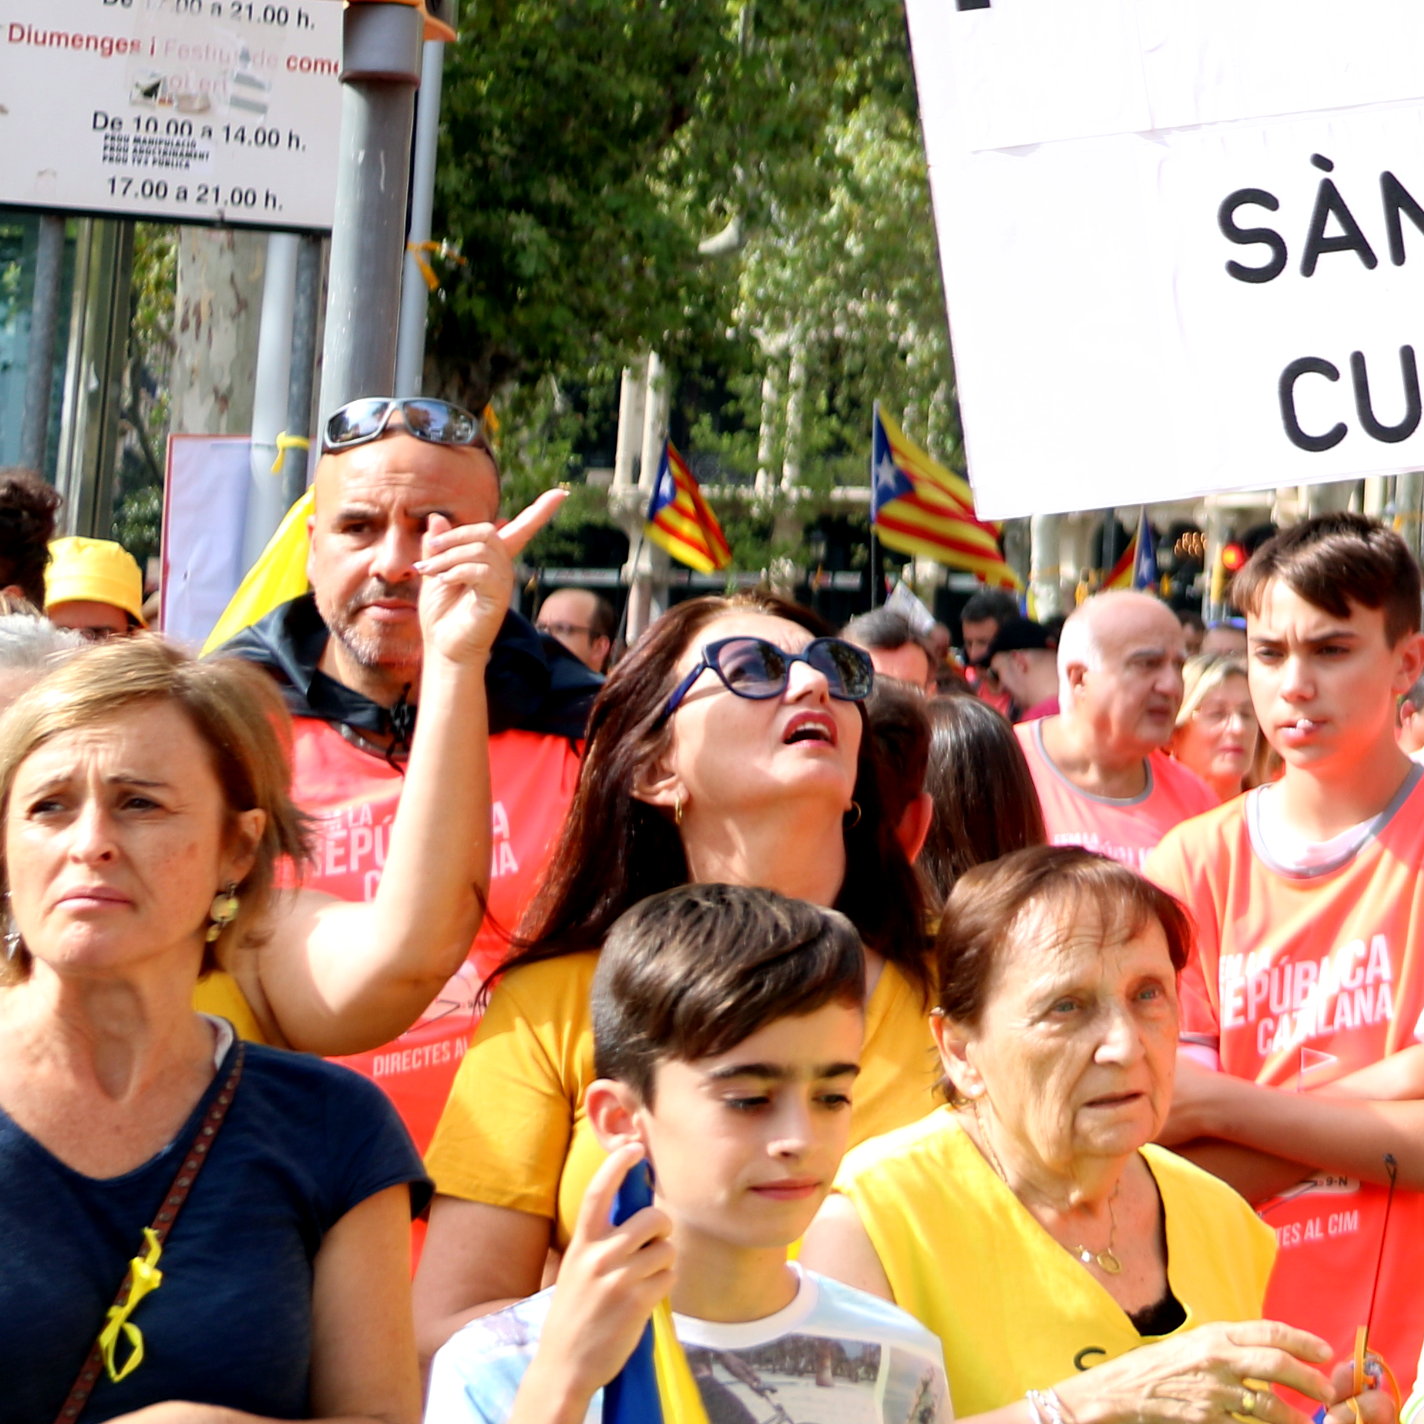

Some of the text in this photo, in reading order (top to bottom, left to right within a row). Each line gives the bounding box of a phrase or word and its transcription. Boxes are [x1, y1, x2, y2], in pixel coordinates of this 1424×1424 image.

[230, 1, 289, 27] 21.00
[297, 7, 316, 30] h.
[7, 22, 142, 58] Diumenges
[149, 36, 156, 56] i
[92, 110, 123, 134] De
[223, 123, 281, 150] 14.00
[287, 127, 306, 152] h.
[107, 175, 284, 211] 17.00 a 21.00 h.
[372, 1039, 450, 1079] DIRECTES
[1304, 1216, 1324, 1241] AL
[1328, 1209, 1359, 1235] CIM
